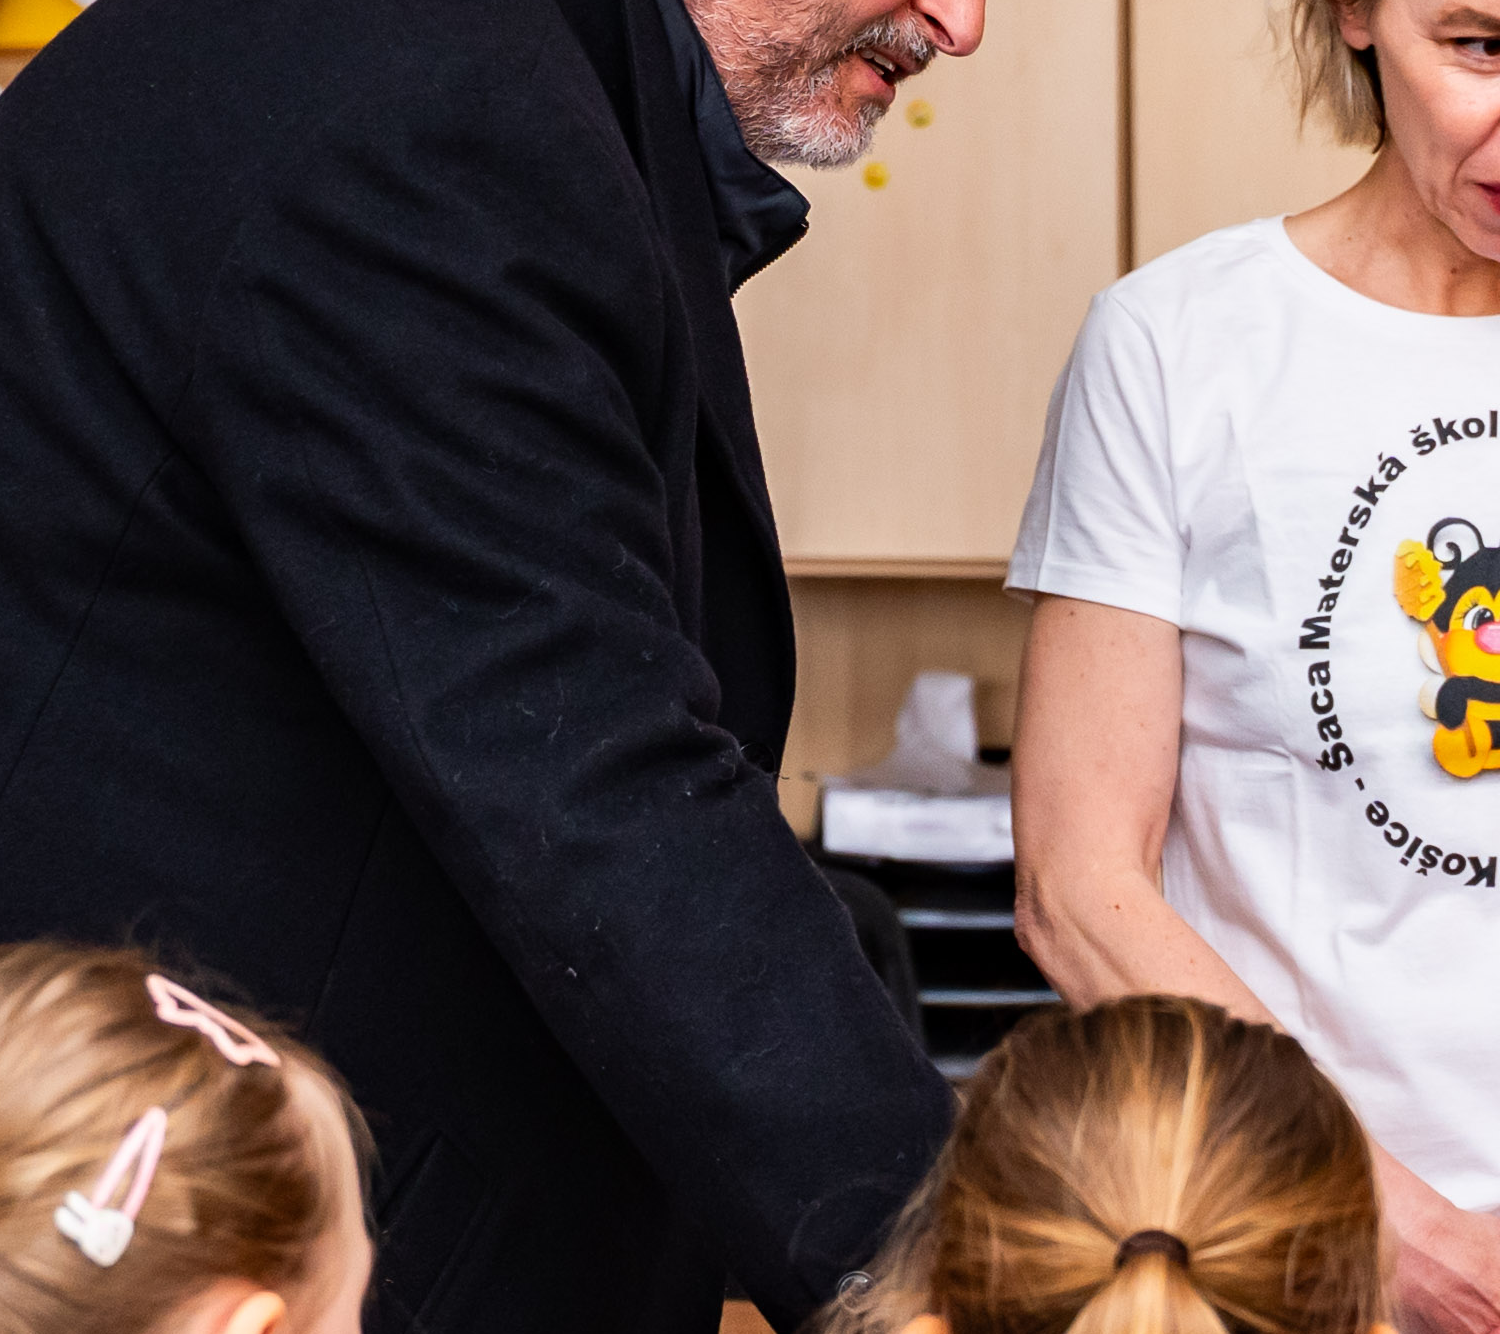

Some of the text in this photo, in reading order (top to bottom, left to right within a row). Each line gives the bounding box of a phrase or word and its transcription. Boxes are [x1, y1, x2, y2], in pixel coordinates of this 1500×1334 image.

[1299, 452, 1408, 650] Materská
[1307, 659, 1355, 773] Šaca
[1365, 800, 1498, 888] Košice
